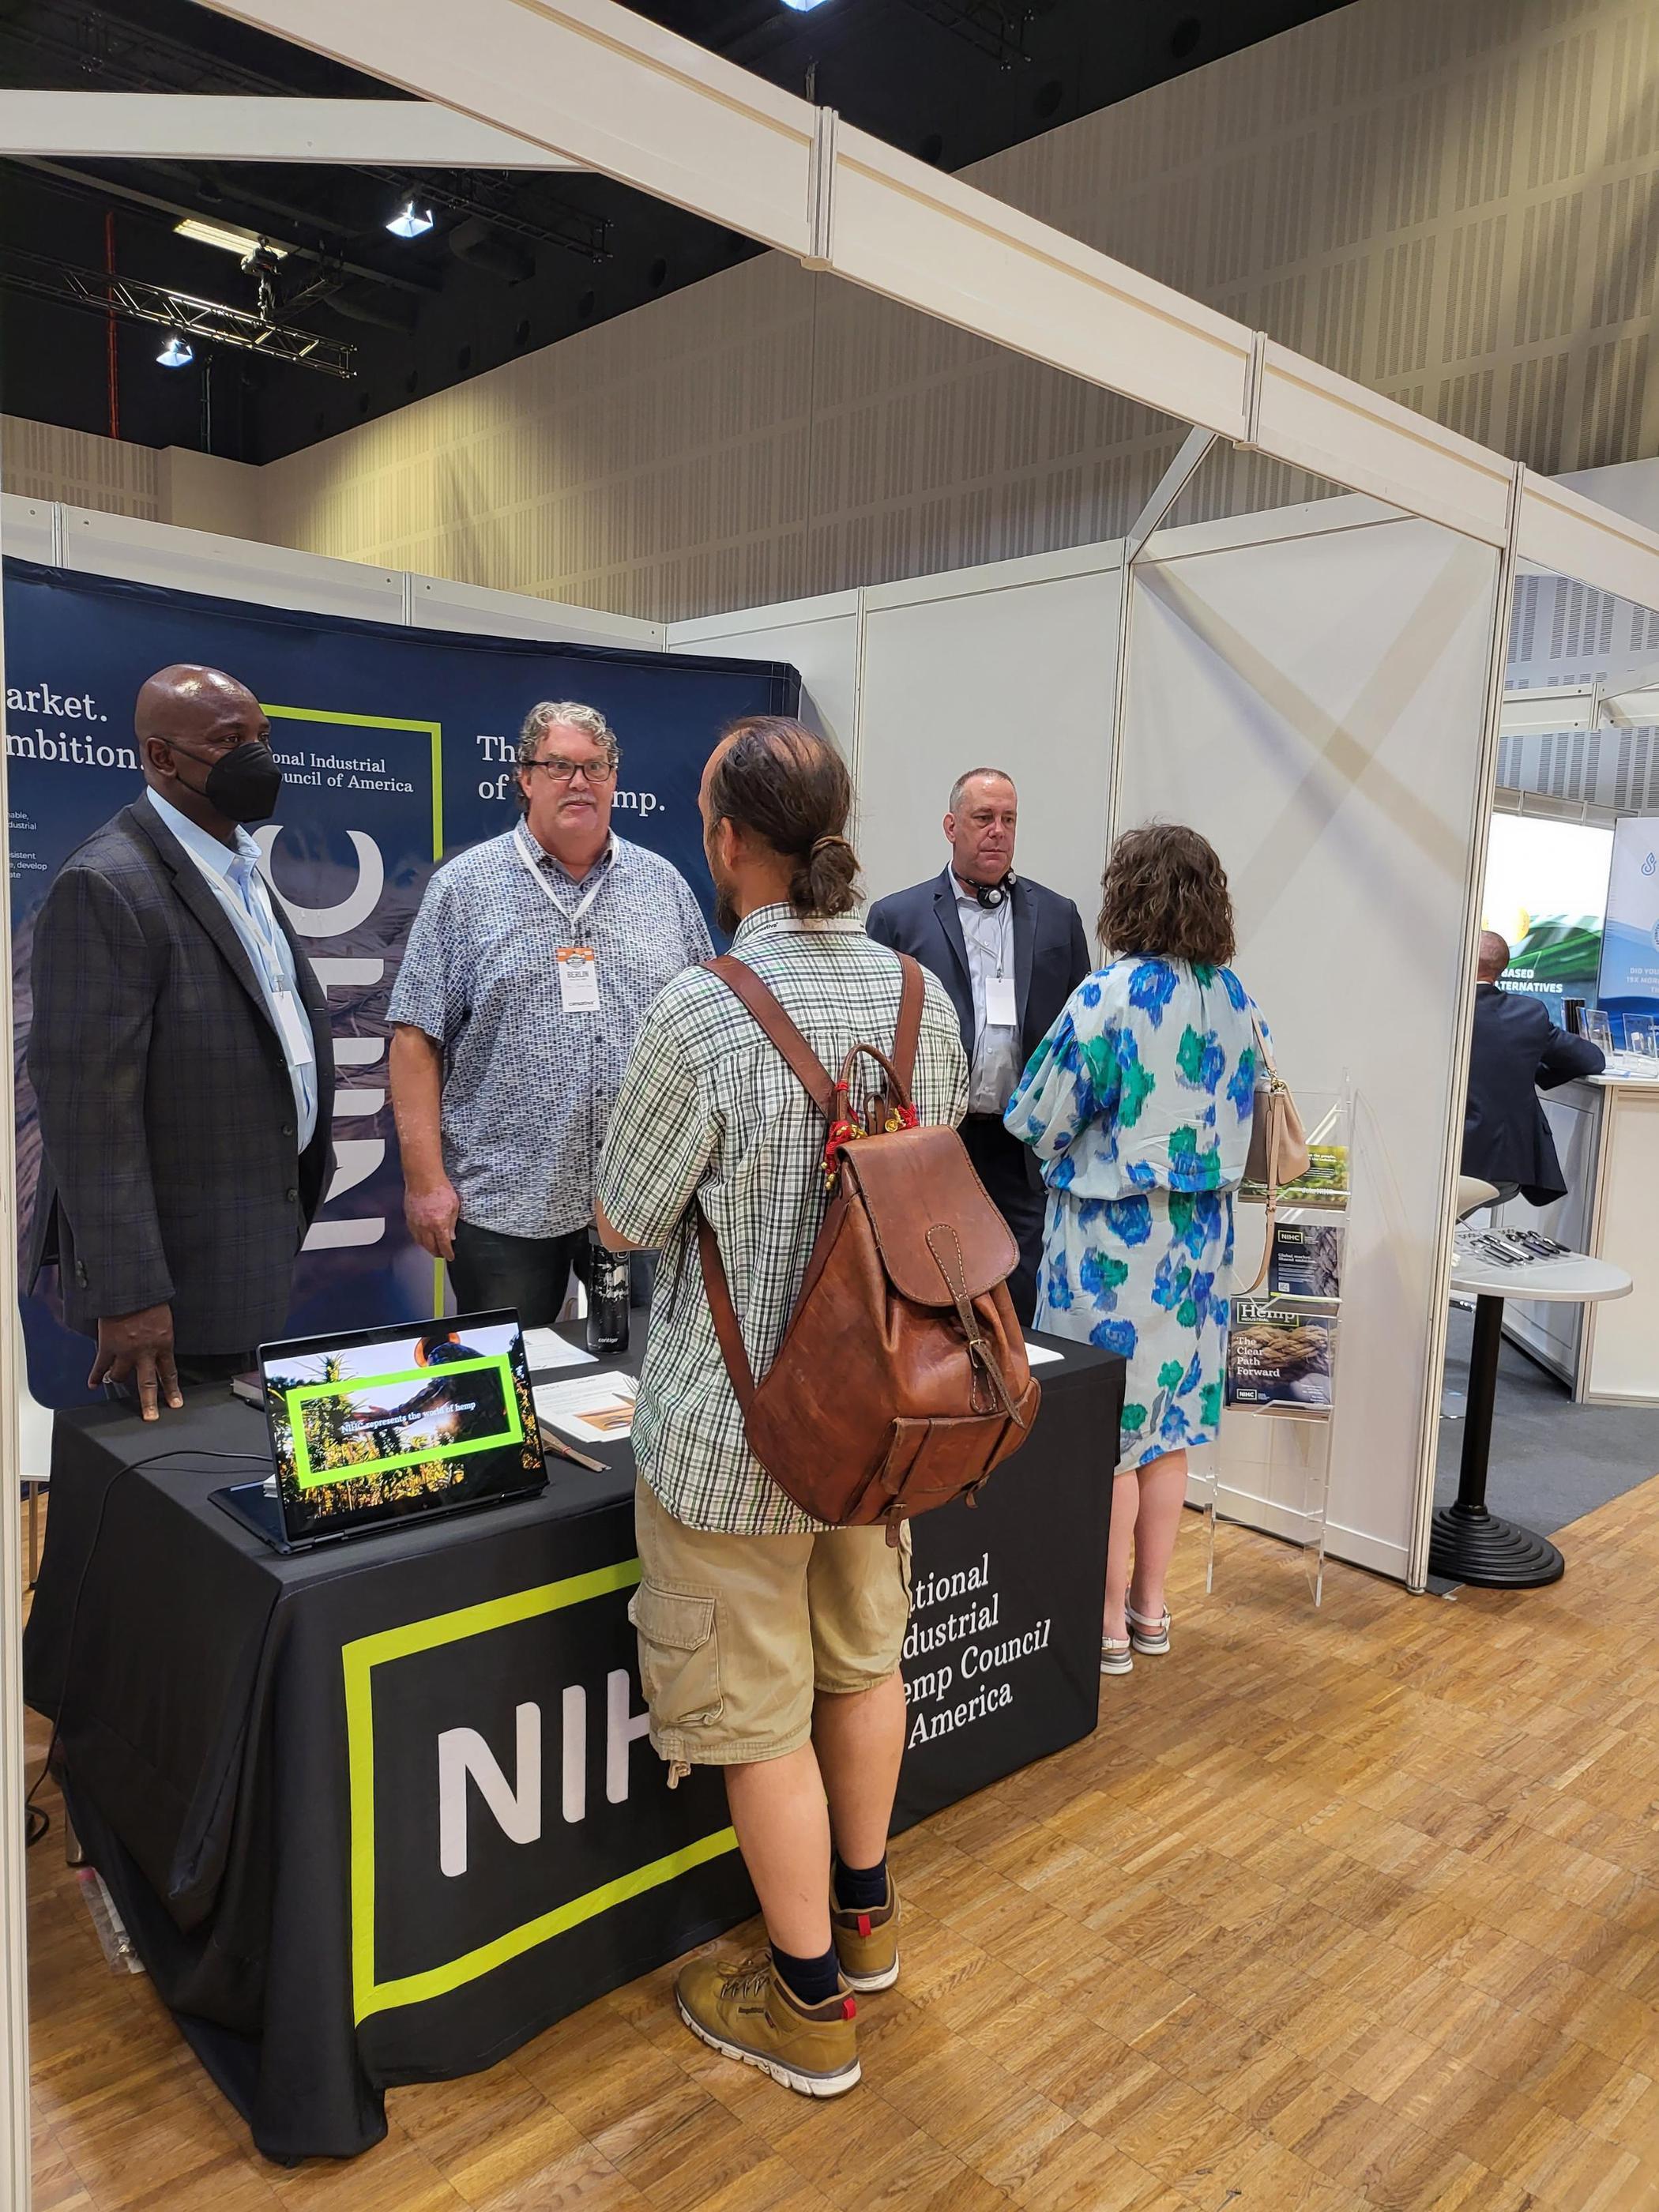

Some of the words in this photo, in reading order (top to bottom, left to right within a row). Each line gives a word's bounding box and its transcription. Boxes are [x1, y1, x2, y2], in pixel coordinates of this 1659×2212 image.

[6, 683, 107, 722] arket.
[310, 753, 386, 773] Industrial
[280, 772, 322, 786] uncil
[327, 773, 344, 788] of
[348, 775, 414, 792] America
[478, 774, 510, 800] of
[17, 861, 47, 871] develop
[1501, 968, 1534, 979] BASED
[1236, 1337, 1257, 1345] The
[1236, 1346, 1264, 1356] Clear
[1236, 1356, 1261, 1366] Path
[1236, 1366, 1280, 1377] Forward
[408, 1412, 421, 1421] the
[445, 1405, 454, 1413] of
[455, 1401, 476, 1411] hemp
[909, 1552, 988, 1612] tional
[903, 1592, 999, 1659] dustrial
[961, 1618, 1051, 1680] Council
[908, 1683, 1014, 1749] America
